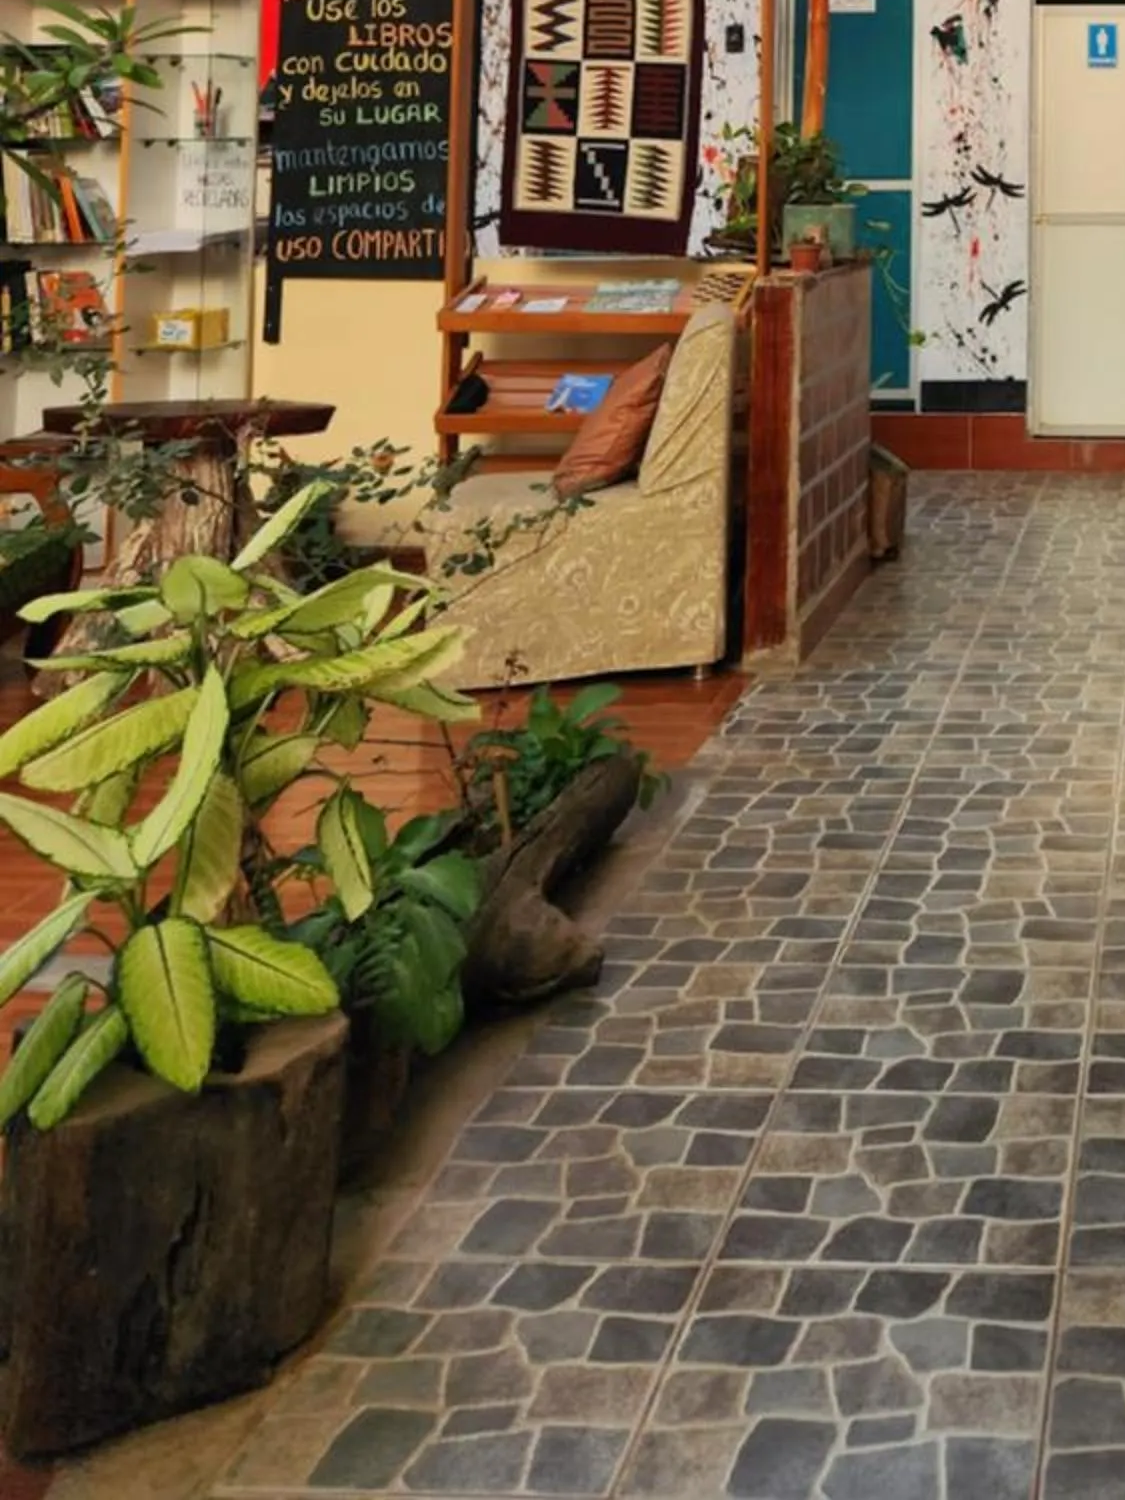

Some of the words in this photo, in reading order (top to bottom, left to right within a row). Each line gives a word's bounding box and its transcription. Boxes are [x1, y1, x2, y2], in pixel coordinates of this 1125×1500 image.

[347, 21, 453, 48] LIBROS
[282, 55, 324, 75] con
[393, 80, 420, 98] en
[356, 102, 442, 125] LUGAR
[275, 139, 450, 173] mantengamos
[309, 169, 416, 197] LIMPIOS
[313, 200, 409, 227] espacios
